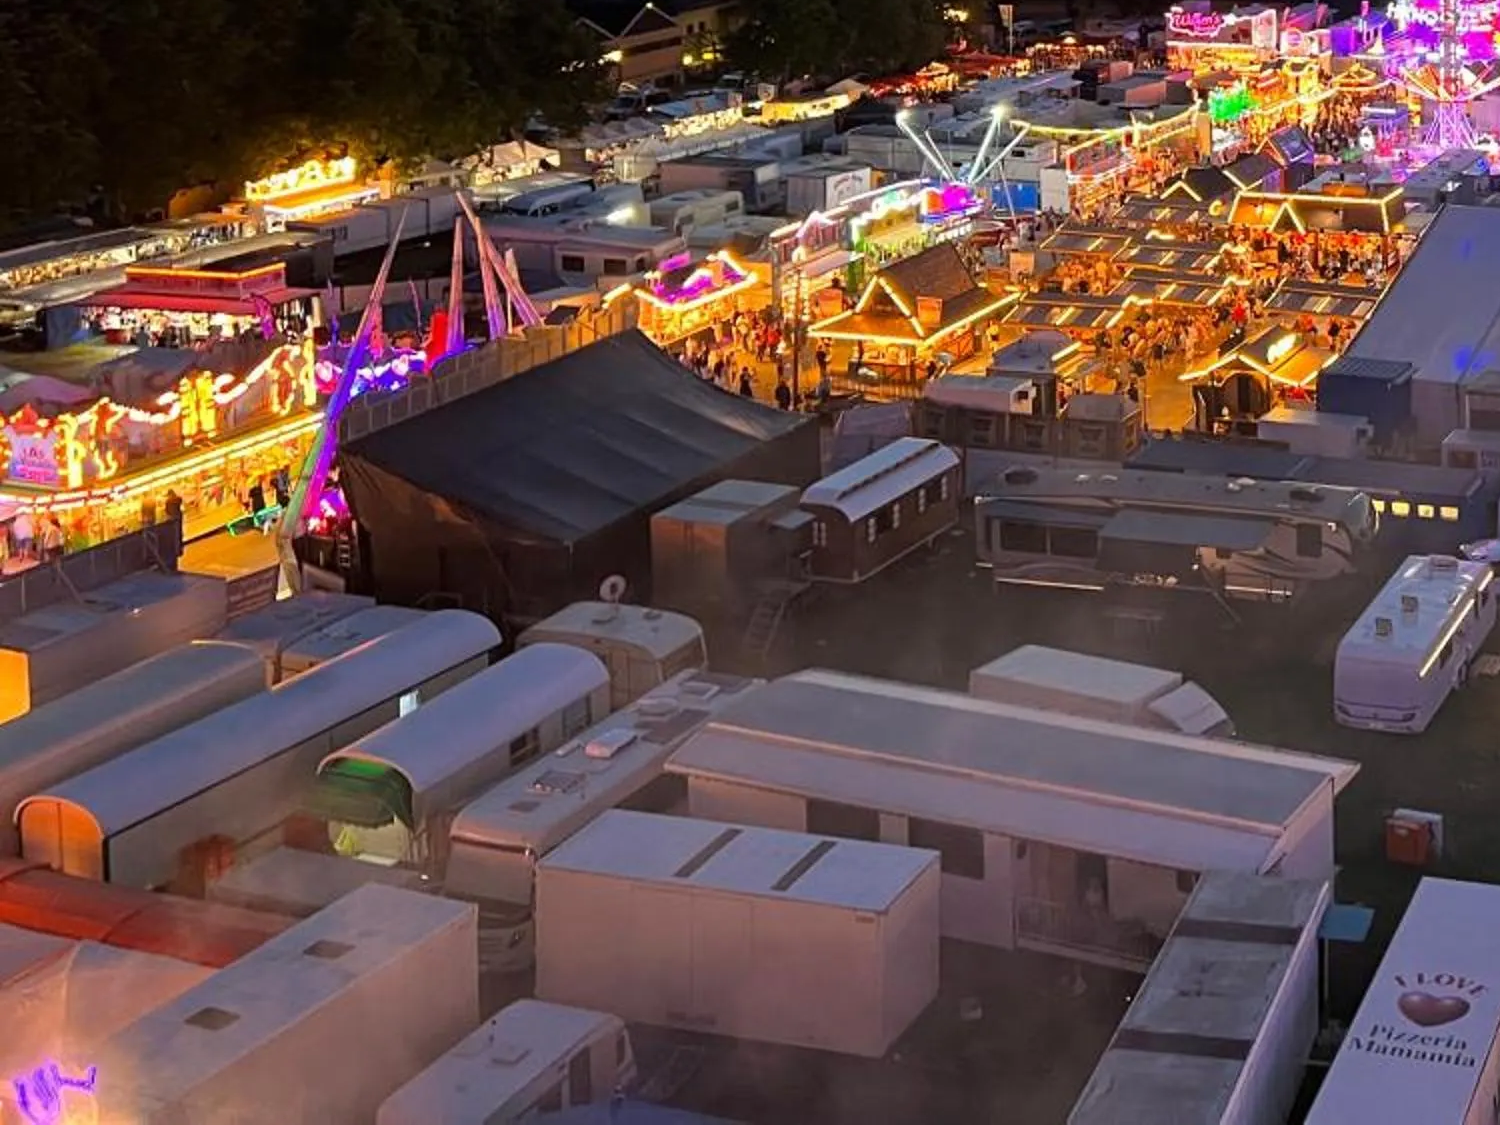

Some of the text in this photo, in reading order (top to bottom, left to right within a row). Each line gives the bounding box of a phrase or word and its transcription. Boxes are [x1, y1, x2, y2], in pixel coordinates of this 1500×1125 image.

[1416, 972, 1489, 997] LOVE
[1369, 1024, 1468, 1052] Pizzeria
[1349, 1037, 1476, 1068] Mamamia
